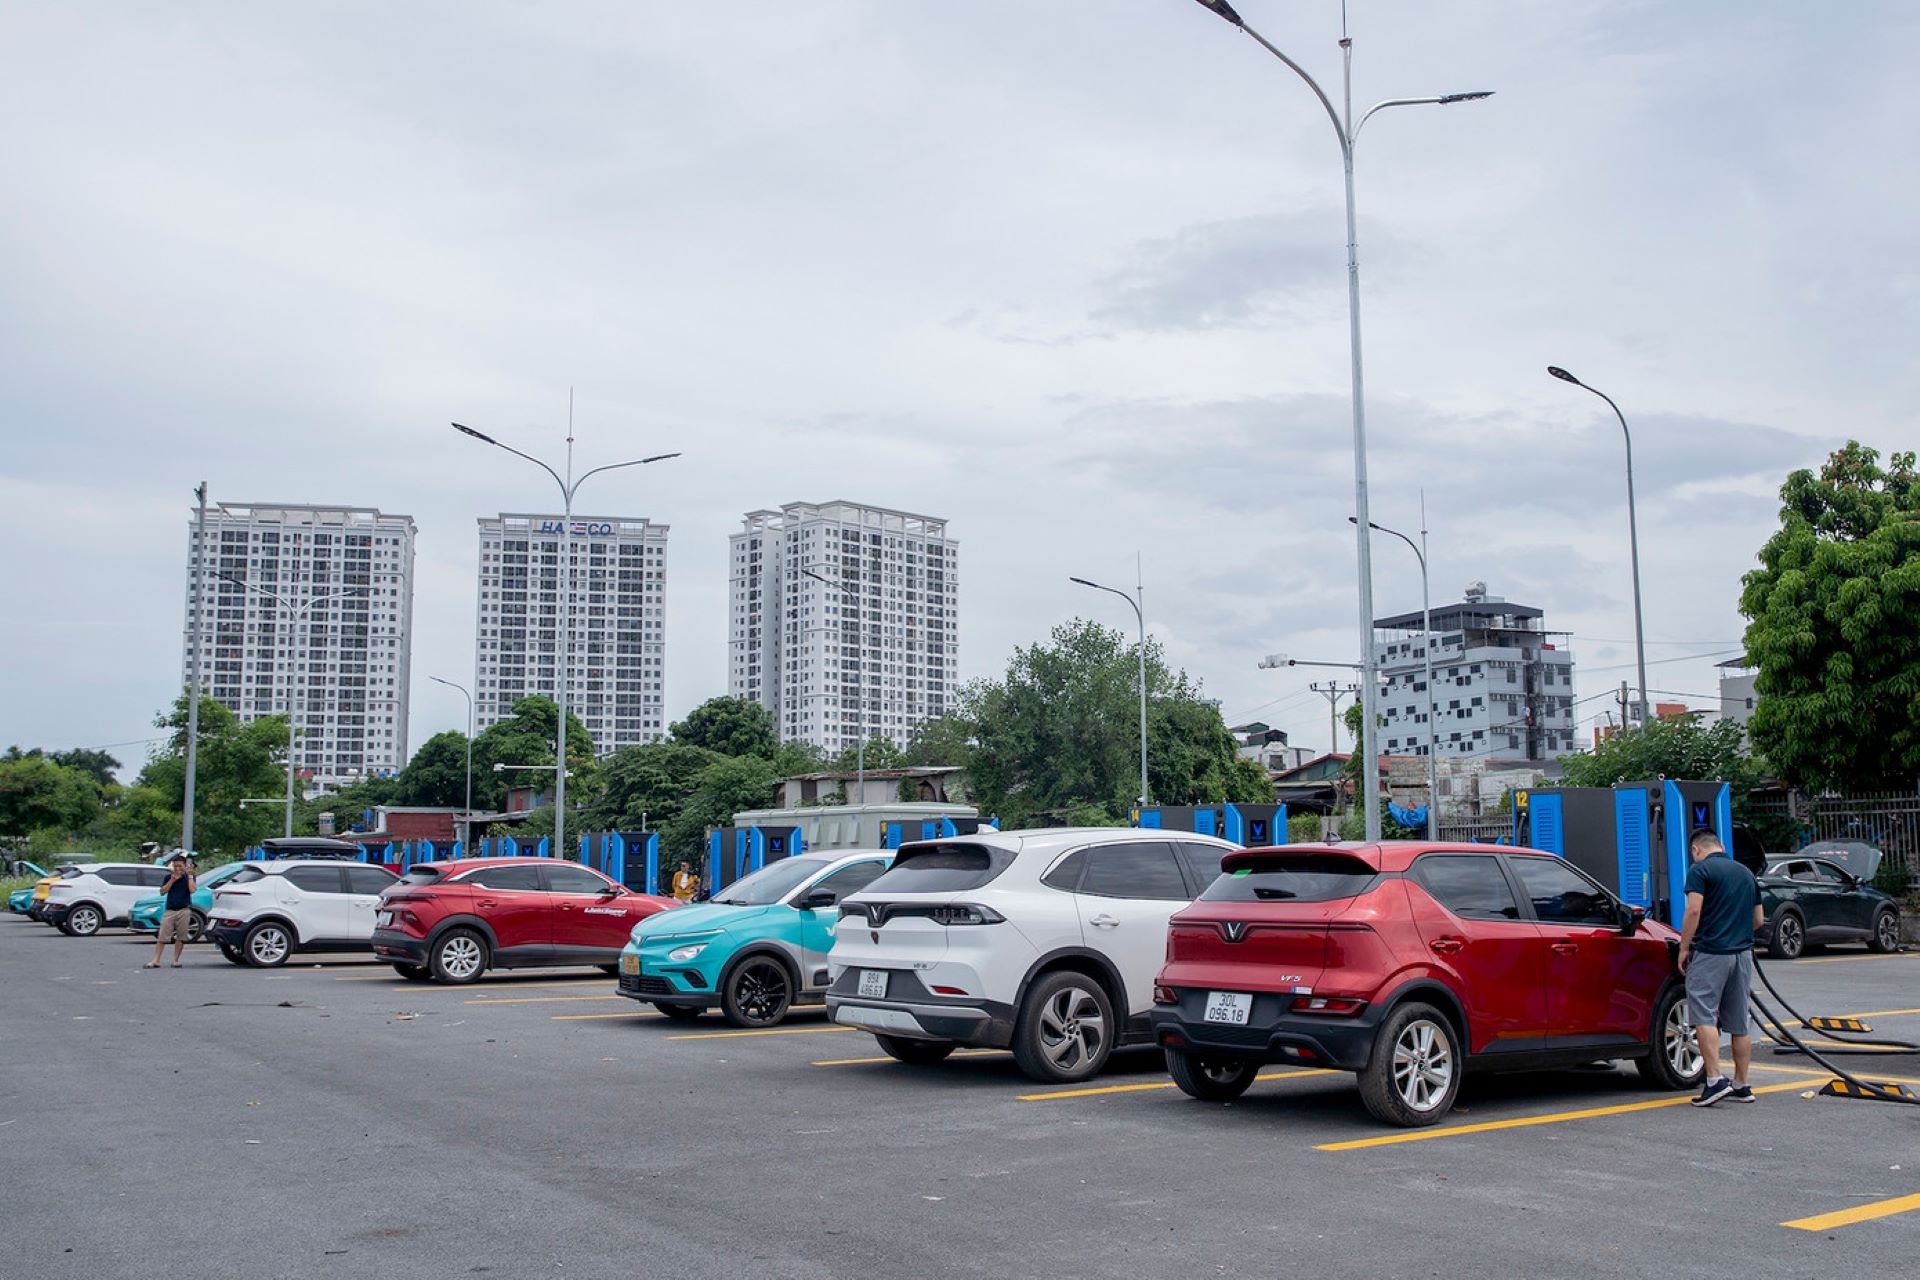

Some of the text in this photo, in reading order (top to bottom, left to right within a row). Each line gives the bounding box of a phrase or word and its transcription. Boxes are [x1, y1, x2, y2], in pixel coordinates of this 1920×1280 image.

[1516, 791, 1528, 807] 12
[1219, 994, 1238, 1007] 30L
[1209, 1007, 1244, 1022] 096.18
